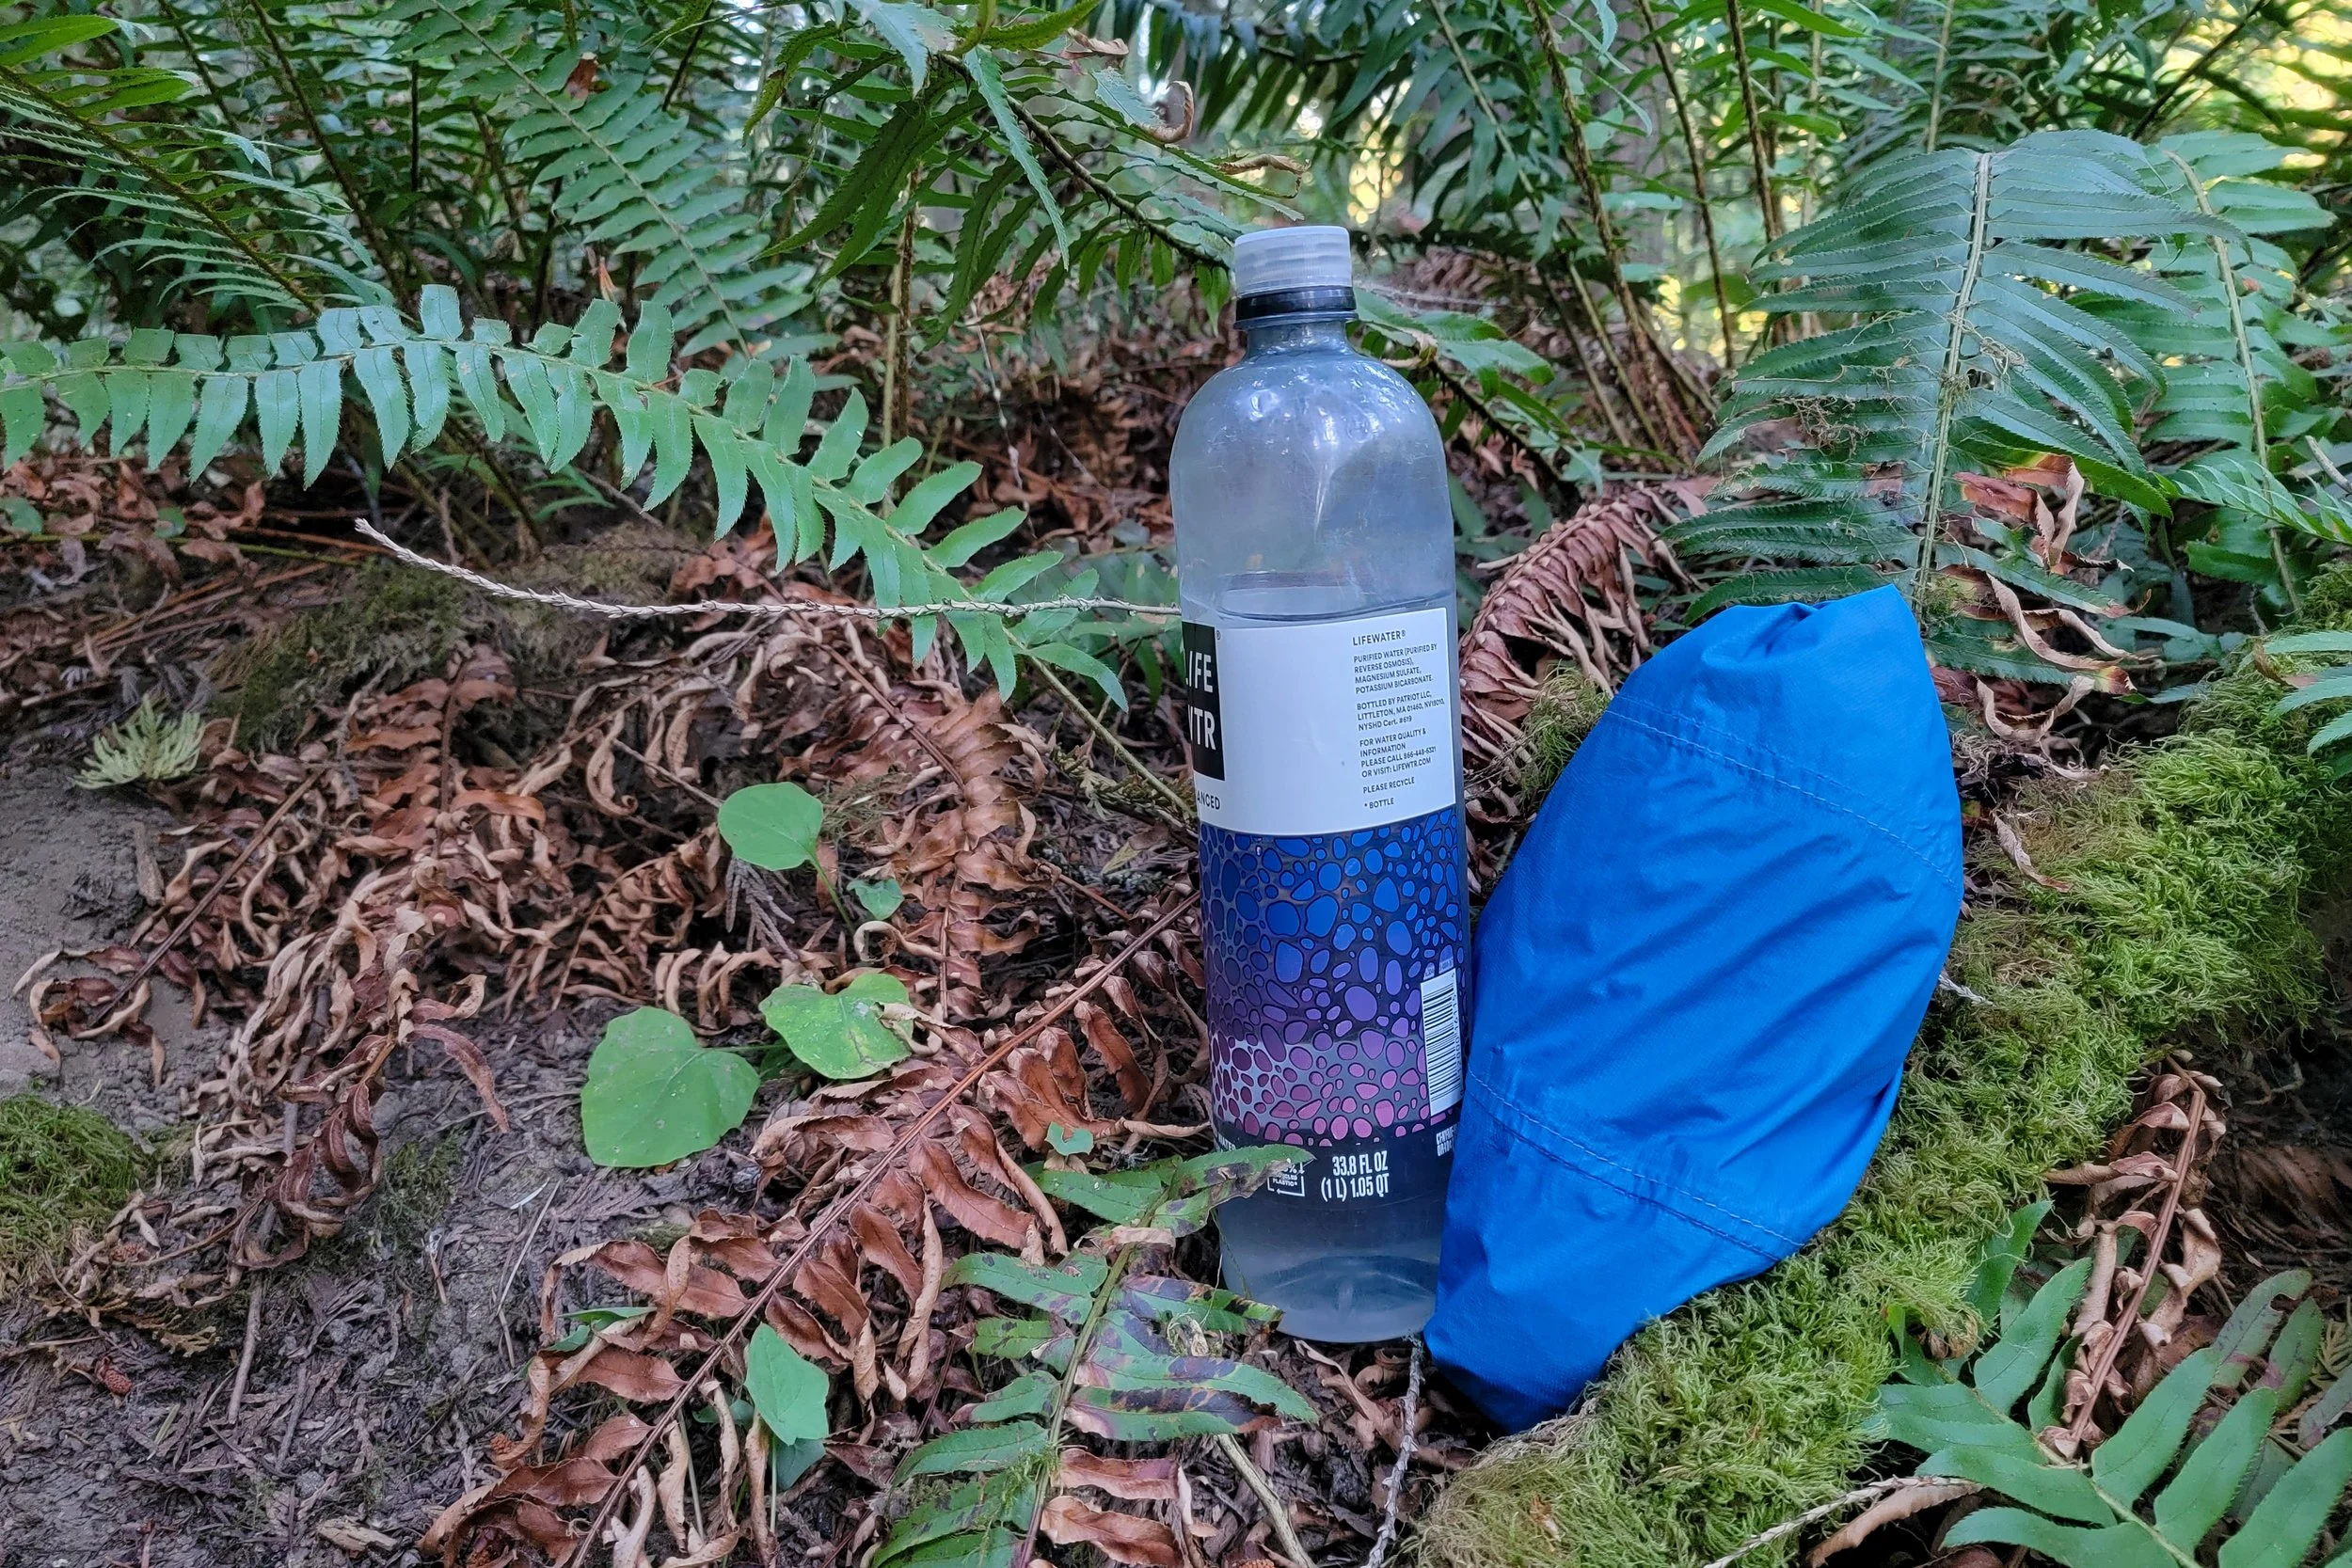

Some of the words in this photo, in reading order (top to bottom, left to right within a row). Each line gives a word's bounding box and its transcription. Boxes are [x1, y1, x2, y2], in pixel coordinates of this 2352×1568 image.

[1353, 652, 1383, 663] PURIFIED
[1383, 648, 1404, 658] WATER
[1404, 644, 1430, 656] (PURIFIED
[1185, 650, 1214, 693] IFE
[1354, 662, 1382, 673] REVERSE
[1355, 671, 1395, 684] MAGNESIUM
[1396, 666, 1422, 677] SULFATE,
[1355, 681, 1393, 694] POTASSIUM
[1357, 699, 1387, 710] BOTTLED
[1396, 692, 1420, 704] PATRIOT
[1358, 707, 1395, 721] LITTLETON,
[1396, 705, 1406, 714] MA
[1358, 721, 1382, 731] NYSHD
[1383, 719, 1398, 727] Cert.
[1359, 737, 1374, 748] FOR
[1375, 735, 1397, 745] WATER
[1397, 728, 1422, 740] QUALITY
[1359, 742, 1406, 757] INFORMATION
[1360, 756, 1386, 768] PLEASE
[1387, 753, 1403, 763] CALL
[1361, 769, 1372, 778] OR
[1373, 766, 1392, 776] VISIT:
[1392, 756, 1432, 772] LIFEWTR.COM
[1362, 783, 1388, 794] PLEASE
[1389, 776, 1415, 789] RECYCLE
[1197, 789, 1220, 810] ANCED
[1369, 798, 1394, 809] BOTTLE
[1332, 1155, 1357, 1176] 33.8
[1359, 1153, 1373, 1175] FL
[1374, 1150, 1389, 1172] OZ
[1321, 1177, 1332, 1203] (1
[1335, 1177, 1347, 1203] L)
[1350, 1175, 1374, 1198] 1.05
[1375, 1173, 1390, 1197] QT
